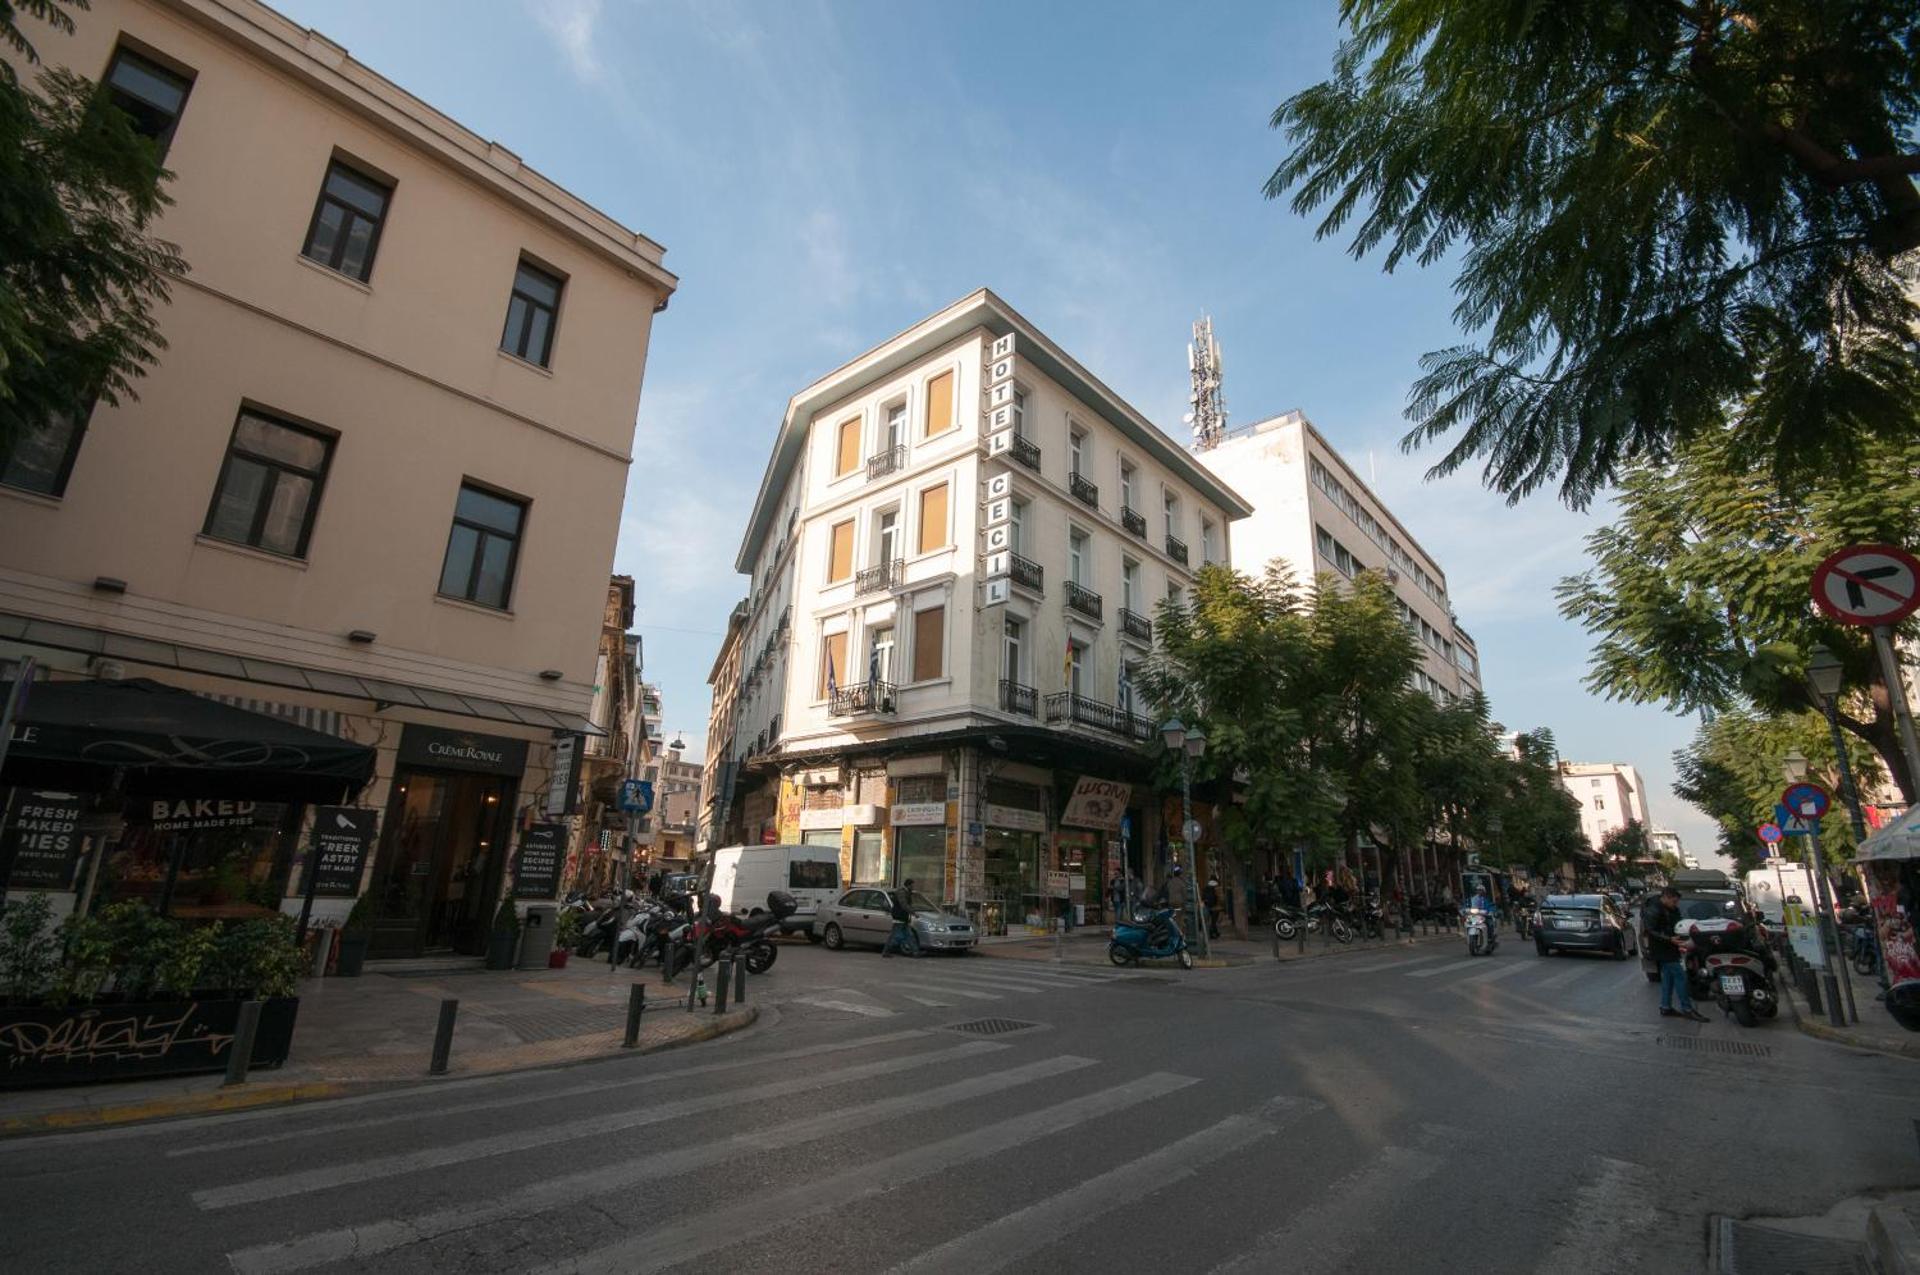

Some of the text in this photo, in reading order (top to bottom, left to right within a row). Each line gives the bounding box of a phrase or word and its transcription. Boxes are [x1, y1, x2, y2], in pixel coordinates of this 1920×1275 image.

[994, 339, 1009, 450] HOTEL
[991, 477, 1005, 600] CECIL
[466, 747, 503, 762] ROYALE
[20, 805, 80, 820] FRESH
[152, 799, 257, 820] BAKED
[153, 817, 255, 831] HOME MADE PIES
[321, 834, 362, 842] TRADITIONAL
[321, 853, 359, 864] ASTRY
[523, 857, 555, 865] RECIPES
